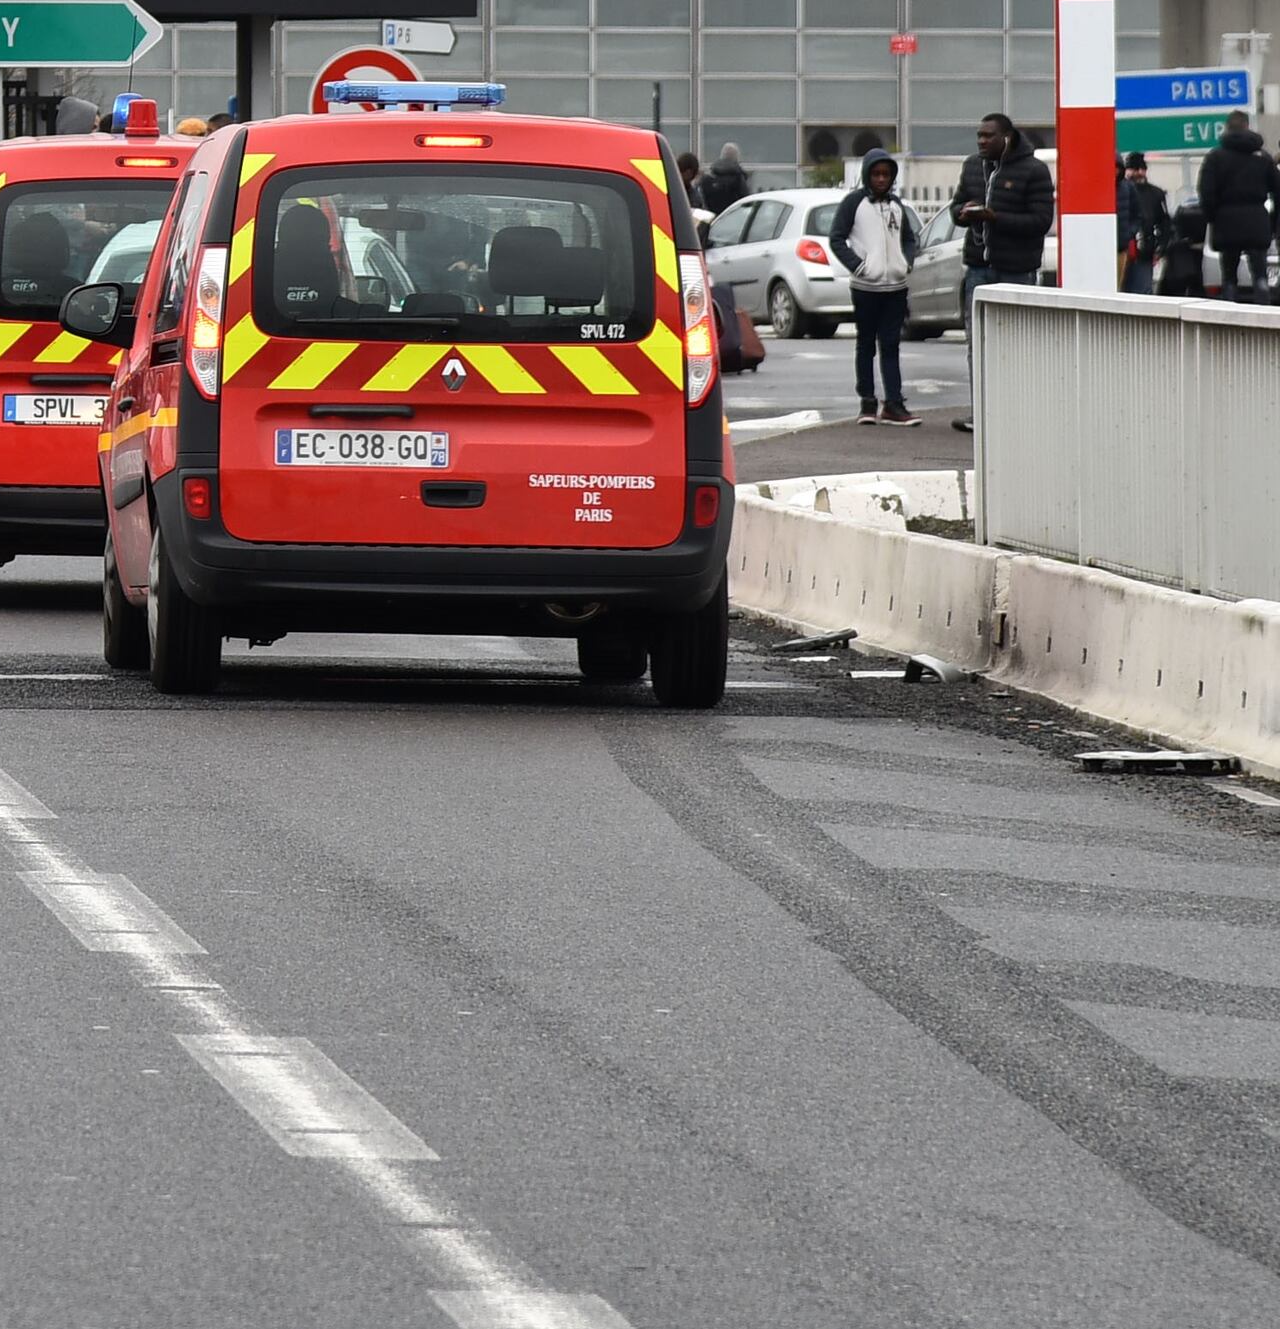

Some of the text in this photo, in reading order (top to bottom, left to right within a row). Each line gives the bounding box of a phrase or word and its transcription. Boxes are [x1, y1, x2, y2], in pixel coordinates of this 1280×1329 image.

[1171, 79, 1240, 101] PARIS
[580, 324, 625, 339] SPVL 472
[33, 398, 80, 418] SPVL
[93, 399, 110, 419] 3
[296, 432, 428, 460] EC-038-GQ
[431, 450, 445, 463] 78
[528, 474, 656, 489] SAPEURS-POMPIERS
[583, 492, 602, 505] DE
[575, 509, 613, 522] PARIS
